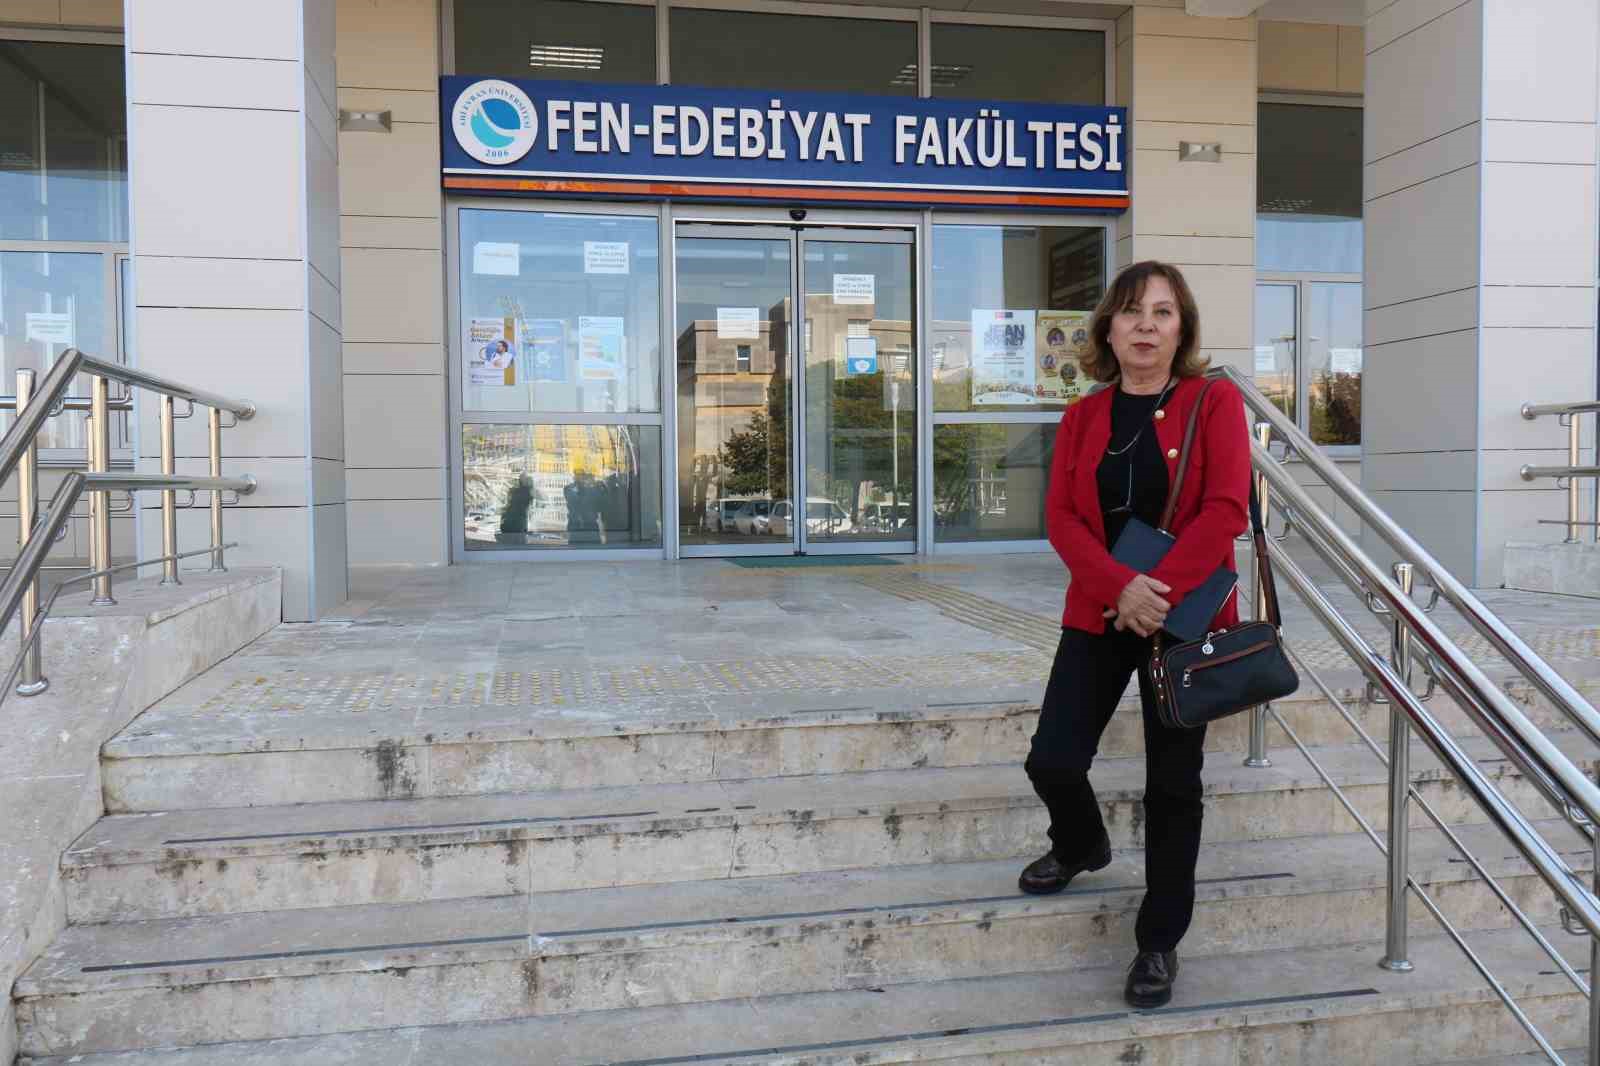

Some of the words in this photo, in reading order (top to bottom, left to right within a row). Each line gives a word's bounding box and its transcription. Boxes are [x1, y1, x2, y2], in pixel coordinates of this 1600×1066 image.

[485, 149, 510, 158] 2006
[547, 99, 871, 162] FEN-EDEBİYAT
[895, 109, 1122, 171] FAKÜLTESİ
